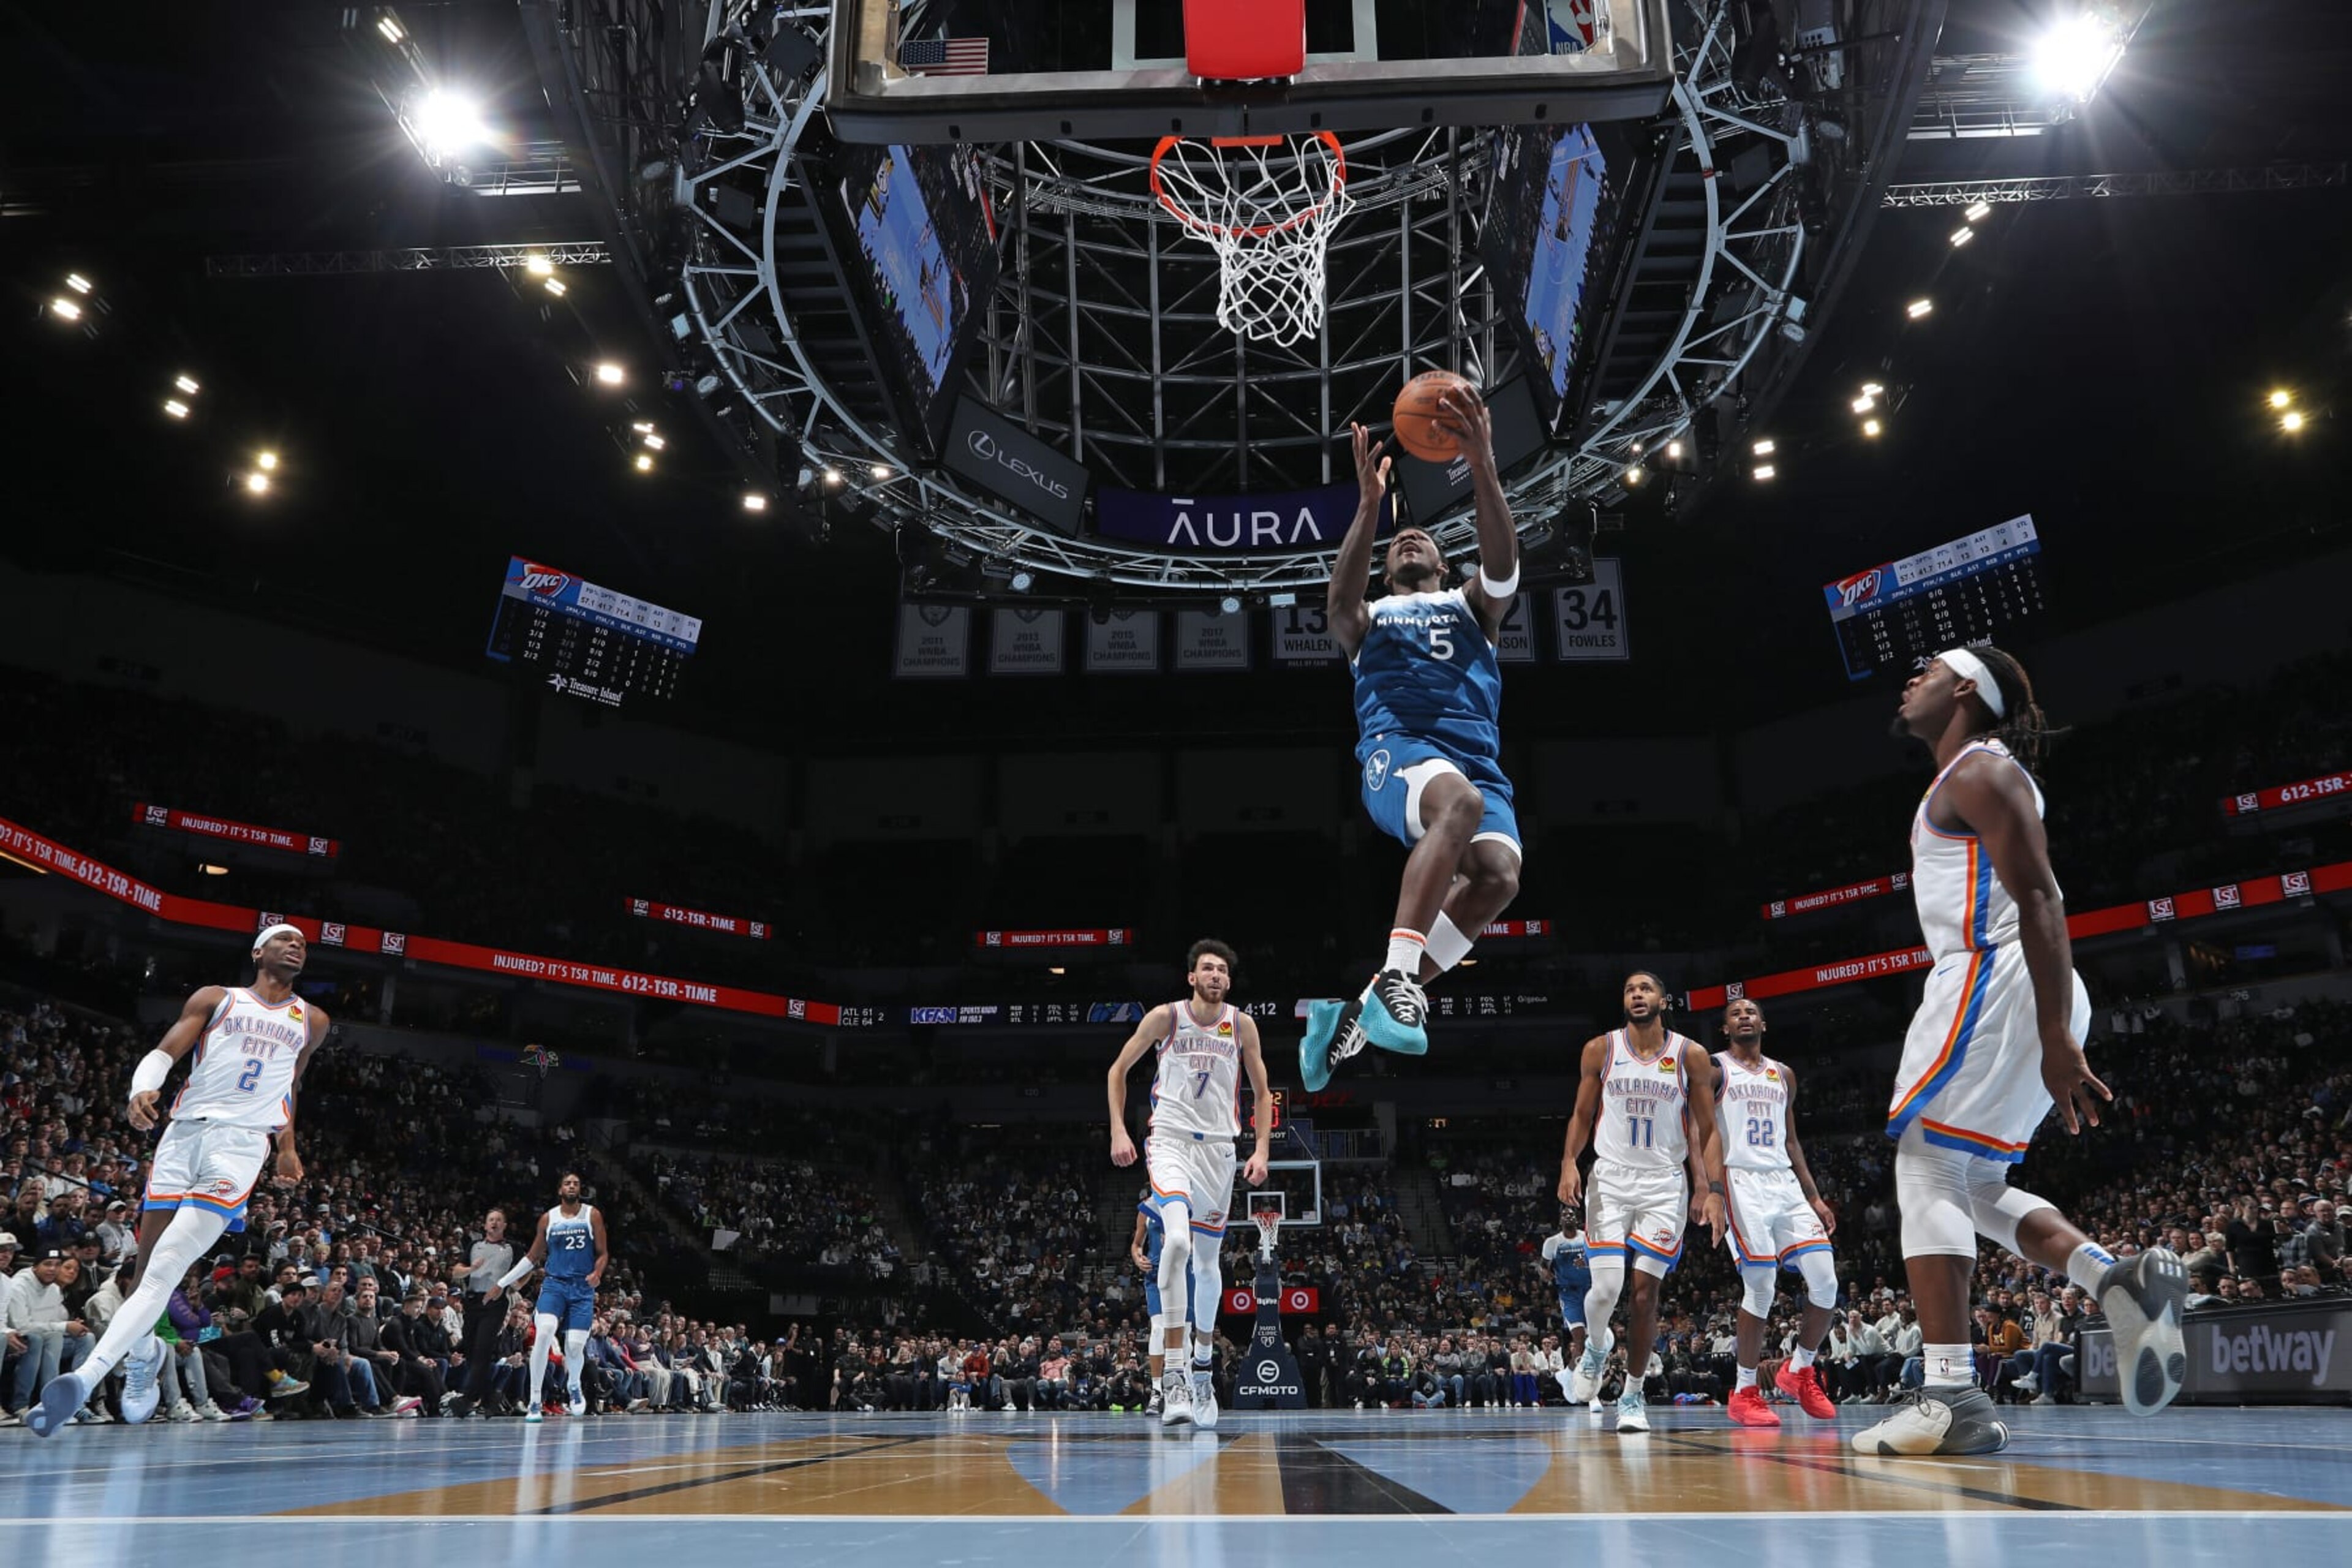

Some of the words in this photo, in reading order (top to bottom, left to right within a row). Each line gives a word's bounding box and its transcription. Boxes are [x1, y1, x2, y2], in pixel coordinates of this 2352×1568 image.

[1556, 41, 1578, 55] NBA
[998, 449, 1069, 499] LEXUS
[519, 573, 560, 589] OKC
[1843, 573, 1873, 607] OKC
[1562, 589, 1618, 630] 34
[1376, 614, 1460, 628] MINNESOTA
[1284, 639, 1332, 650] WHALEN
[1429, 628, 1454, 660] 5
[1569, 635, 1617, 647] FOWLES
[998, 653, 1056, 663] CHAMPIONS
[1093, 650, 1150, 661] CHAMPIONS
[1183, 649, 1241, 658] CHAMPIONS
[569, 676, 600, 696] Treasure
[600, 687, 624, 703] Island
[181, 816, 228, 835] INJURED?
[230, 826, 249, 839] IT'S
[251, 829, 266, 843] TSR
[269, 832, 293, 847] TIME.
[12, 831, 33, 853] IT'S
[35, 840, 53, 861] TSR
[77, 859, 163, 912] 612-TSR-TIME
[663, 908, 736, 932] 612-TSR-TIME
[1816, 962, 1864, 982] INJURED?
[1867, 957, 1888, 973] IT'S
[1890, 953, 1910, 968] TSR
[1912, 949, 1934, 963] TIM
[492, 954, 545, 973] INJURED?
[548, 963, 568, 978] IT'S
[570, 967, 589, 981] TSR
[592, 970, 619, 986] TIME.
[621, 974, 717, 1003] 612-TSR-TIME
[842, 1008, 859, 1017] ATL
[877, 1012, 884, 1022] 2
[910, 1006, 957, 1023] KFAN
[1245, 1003, 1277, 1017] 4:12
[842, 1017, 859, 1026] CLE
[862, 1017, 873, 1026] 64
[224, 1016, 304, 1054] OKLAHOMA
[241, 1033, 279, 1060] CITY
[1172, 1038, 1235, 1055] OKLAHOMA
[235, 1058, 263, 1094] 2
[1195, 1072, 1210, 1099] 7
[1607, 1076, 1678, 1099] OKLAHOMA
[1727, 1084, 1787, 1101] OKLAHOMA
[1625, 1098, 1658, 1116] CITY
[1746, 1101, 1771, 1116] CITY
[1628, 1116, 1654, 1150] 11
[1746, 1118, 1776, 1148] 22
[565, 1235, 586, 1250] 23
[2211, 1324, 2336, 1386] betway
[1239, 1385, 1298, 1396] CFMOTO
